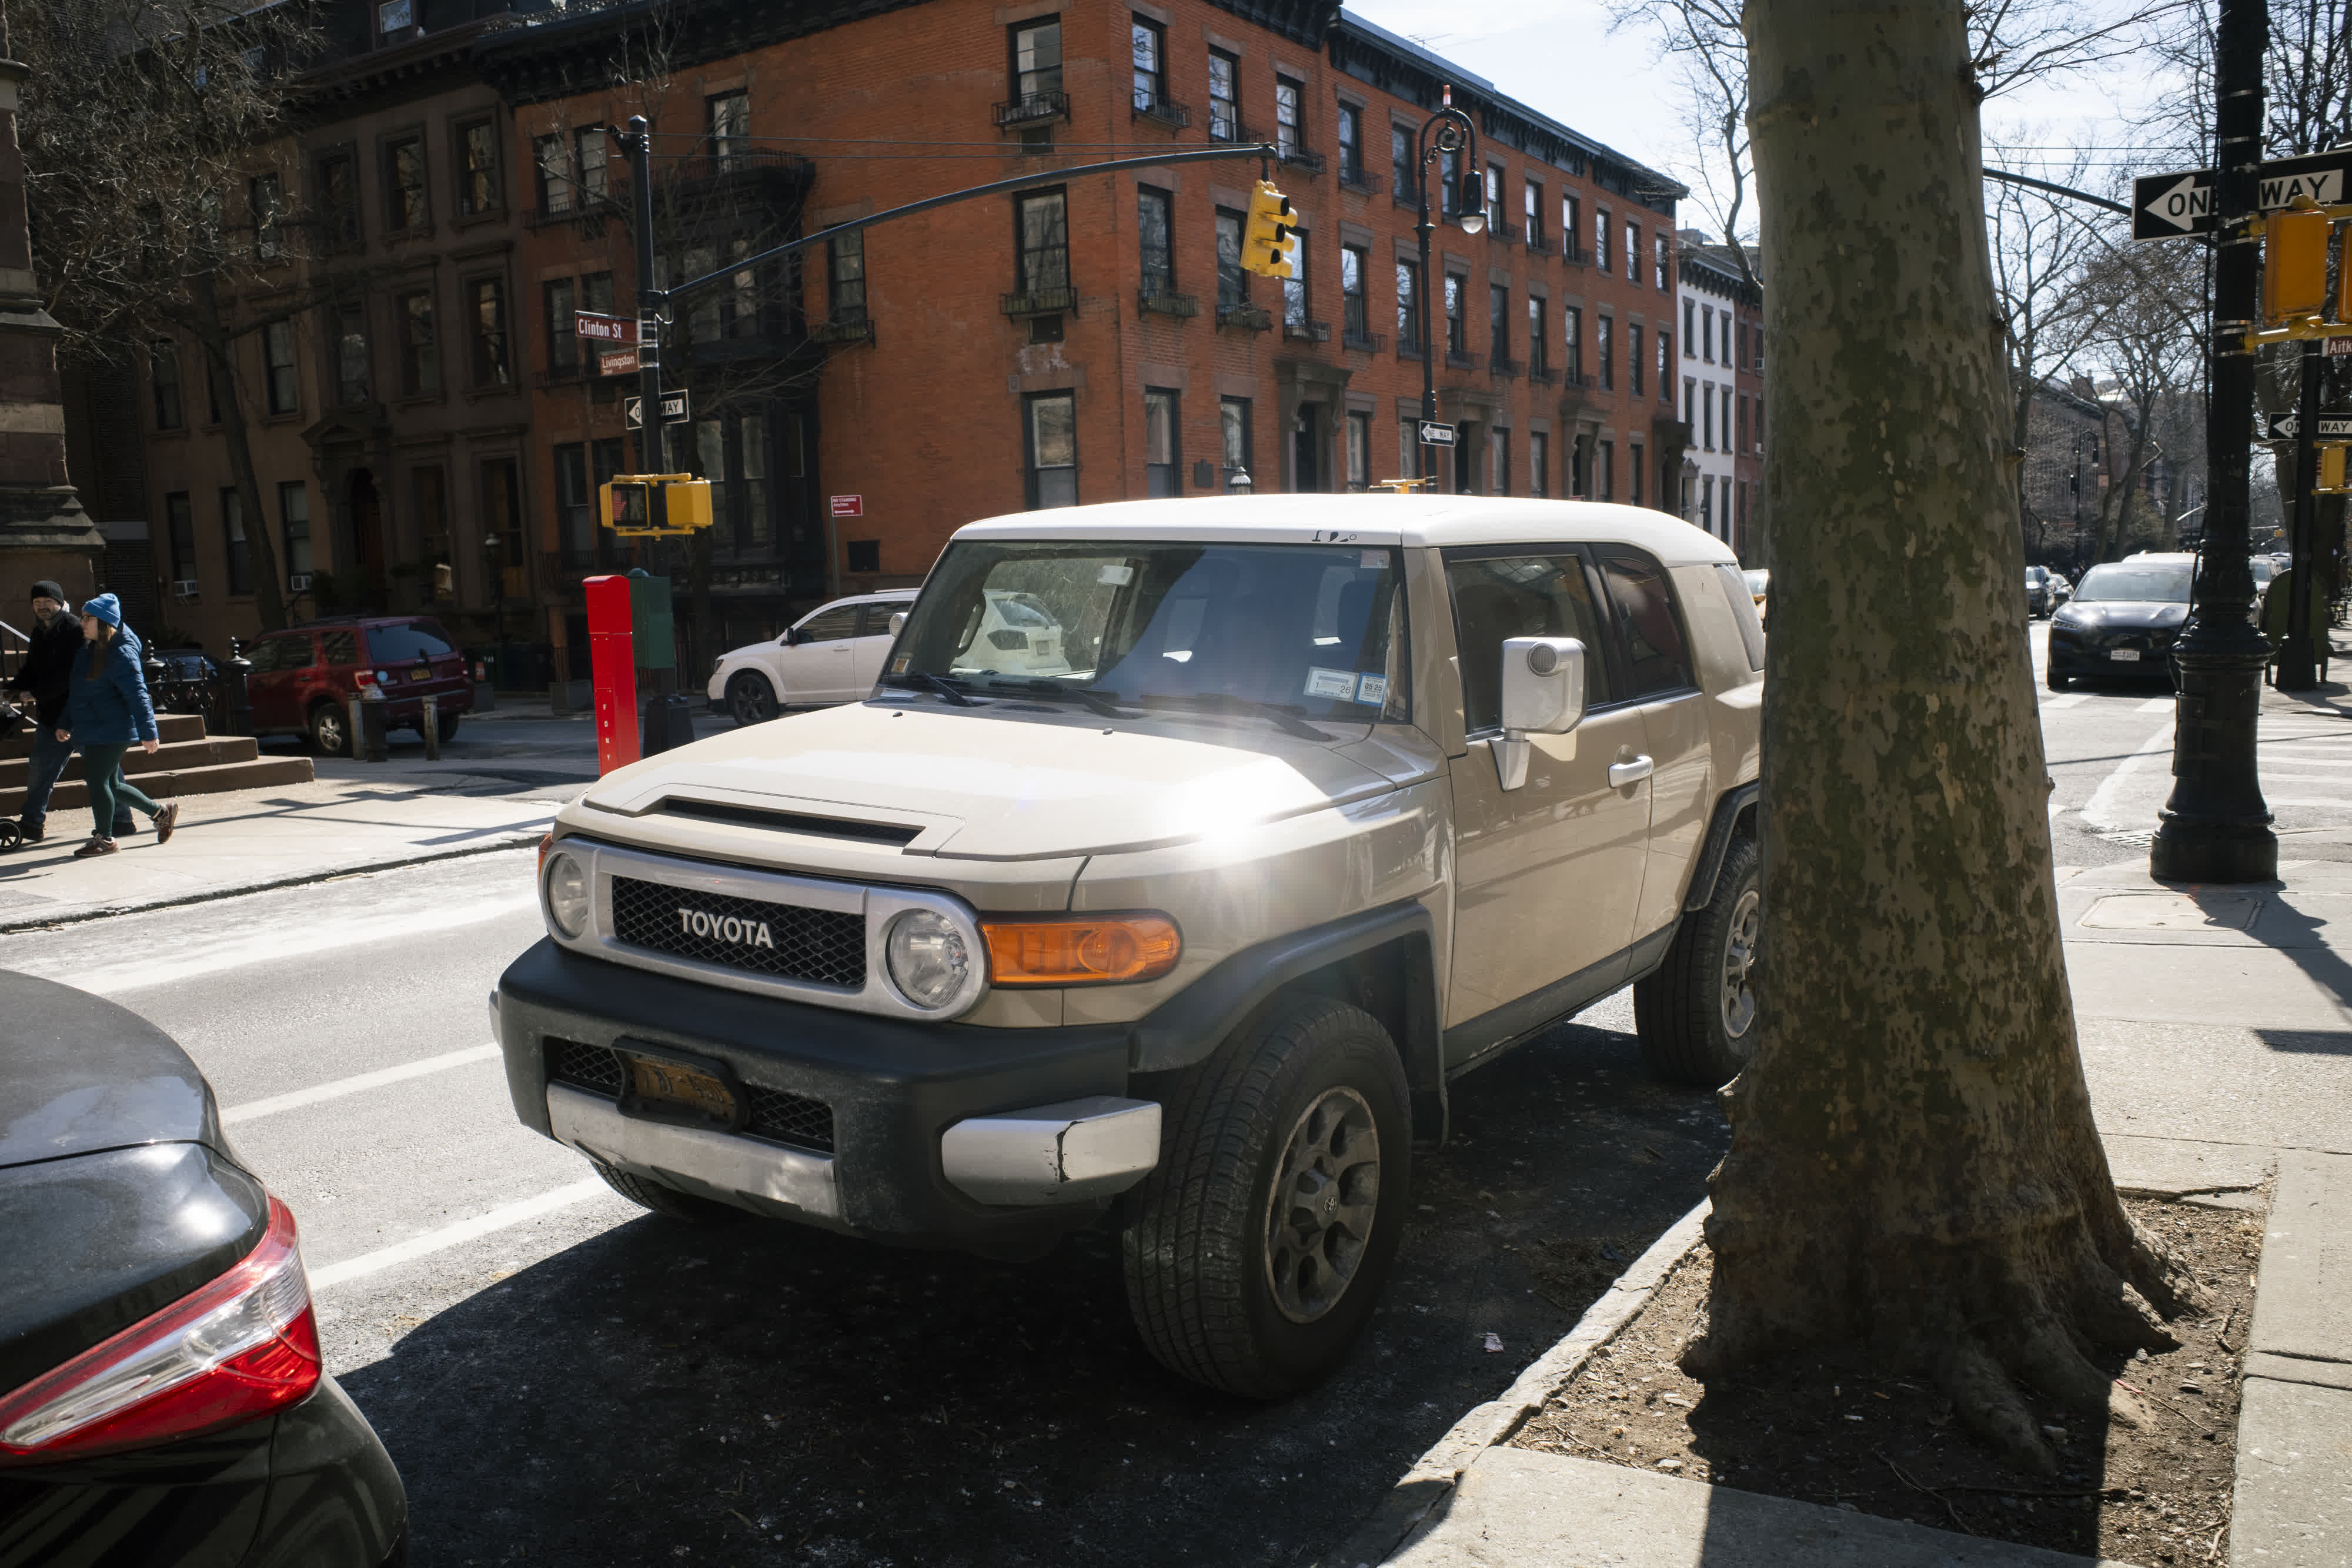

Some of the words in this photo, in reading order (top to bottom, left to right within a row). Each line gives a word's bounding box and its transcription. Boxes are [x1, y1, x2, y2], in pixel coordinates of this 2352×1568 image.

[2167, 189, 2208, 217] ON
[2260, 174, 2329, 206] WAY
[579, 319, 610, 337] Clinton
[613, 323, 622, 339] St
[602, 353, 635, 370] Livingston
[1425, 428, 1435, 438] ONE
[1439, 430, 1450, 439] WAY
[2320, 422, 2349, 433] WAY
[1340, 685, 1352, 694] 26
[677, 907, 774, 950] TOYOTA
